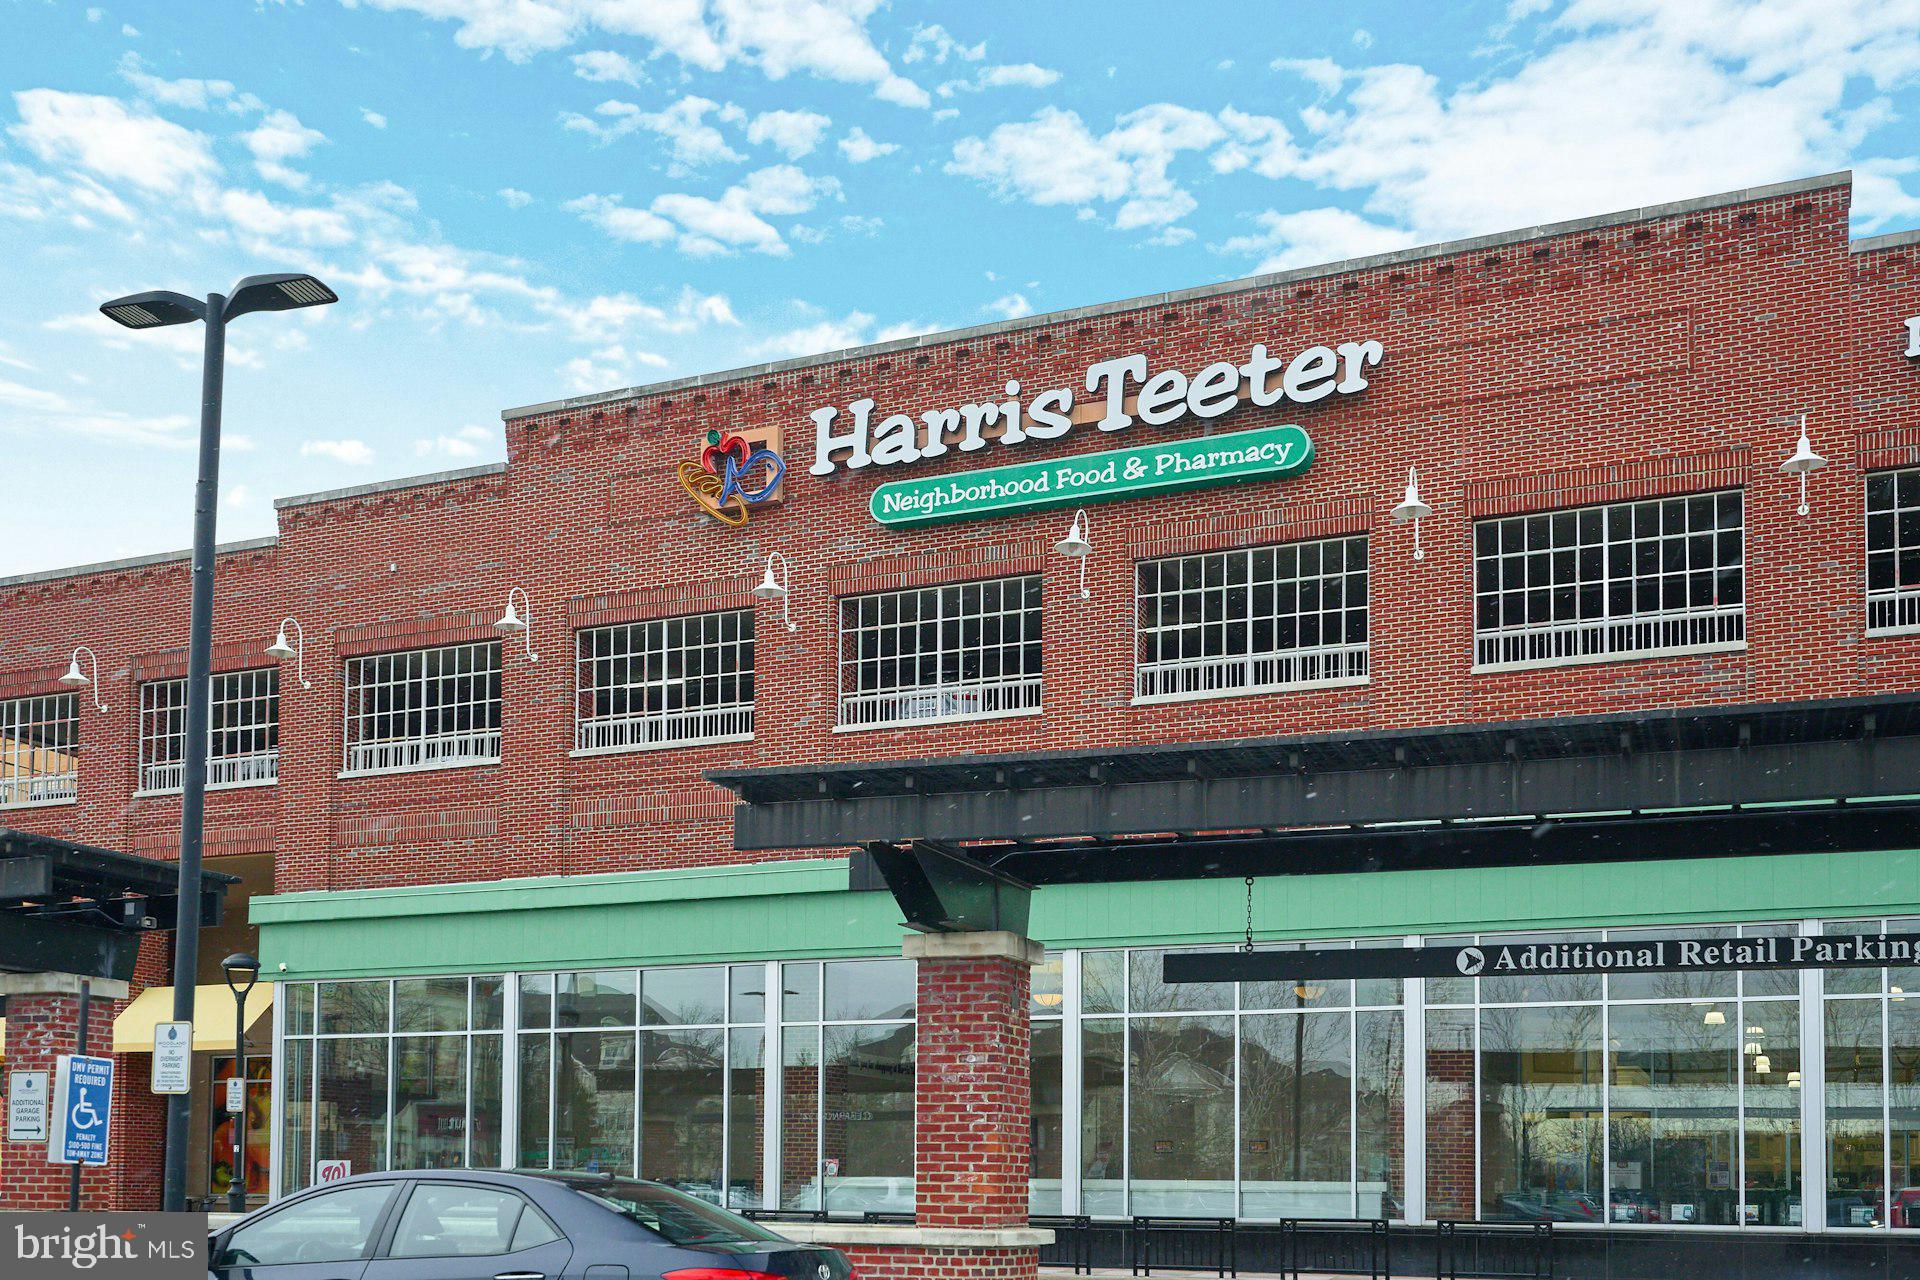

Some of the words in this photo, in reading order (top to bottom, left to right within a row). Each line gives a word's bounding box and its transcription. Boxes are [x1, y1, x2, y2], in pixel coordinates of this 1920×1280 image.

[809, 380, 1073, 475] Harris
[1085, 340, 1384, 432] Teeter
[882, 472, 1050, 514] Neighborhood
[1056, 461, 1117, 489] Food
[1123, 456, 1149, 480] &
[1155, 441, 1294, 475] Pharmacy
[1493, 943, 1666, 970] Additional
[1677, 937, 1778, 966] Retail
[72, 1061, 86, 1072] DMV
[87, 1063, 110, 1075] PERMIT
[74, 1073, 106, 1087] REQUIRED
[76, 1132, 96, 1141] PENALTY
[91, 1143, 103, 1151] FINE
[90, 1151, 103, 1159] ZONE
